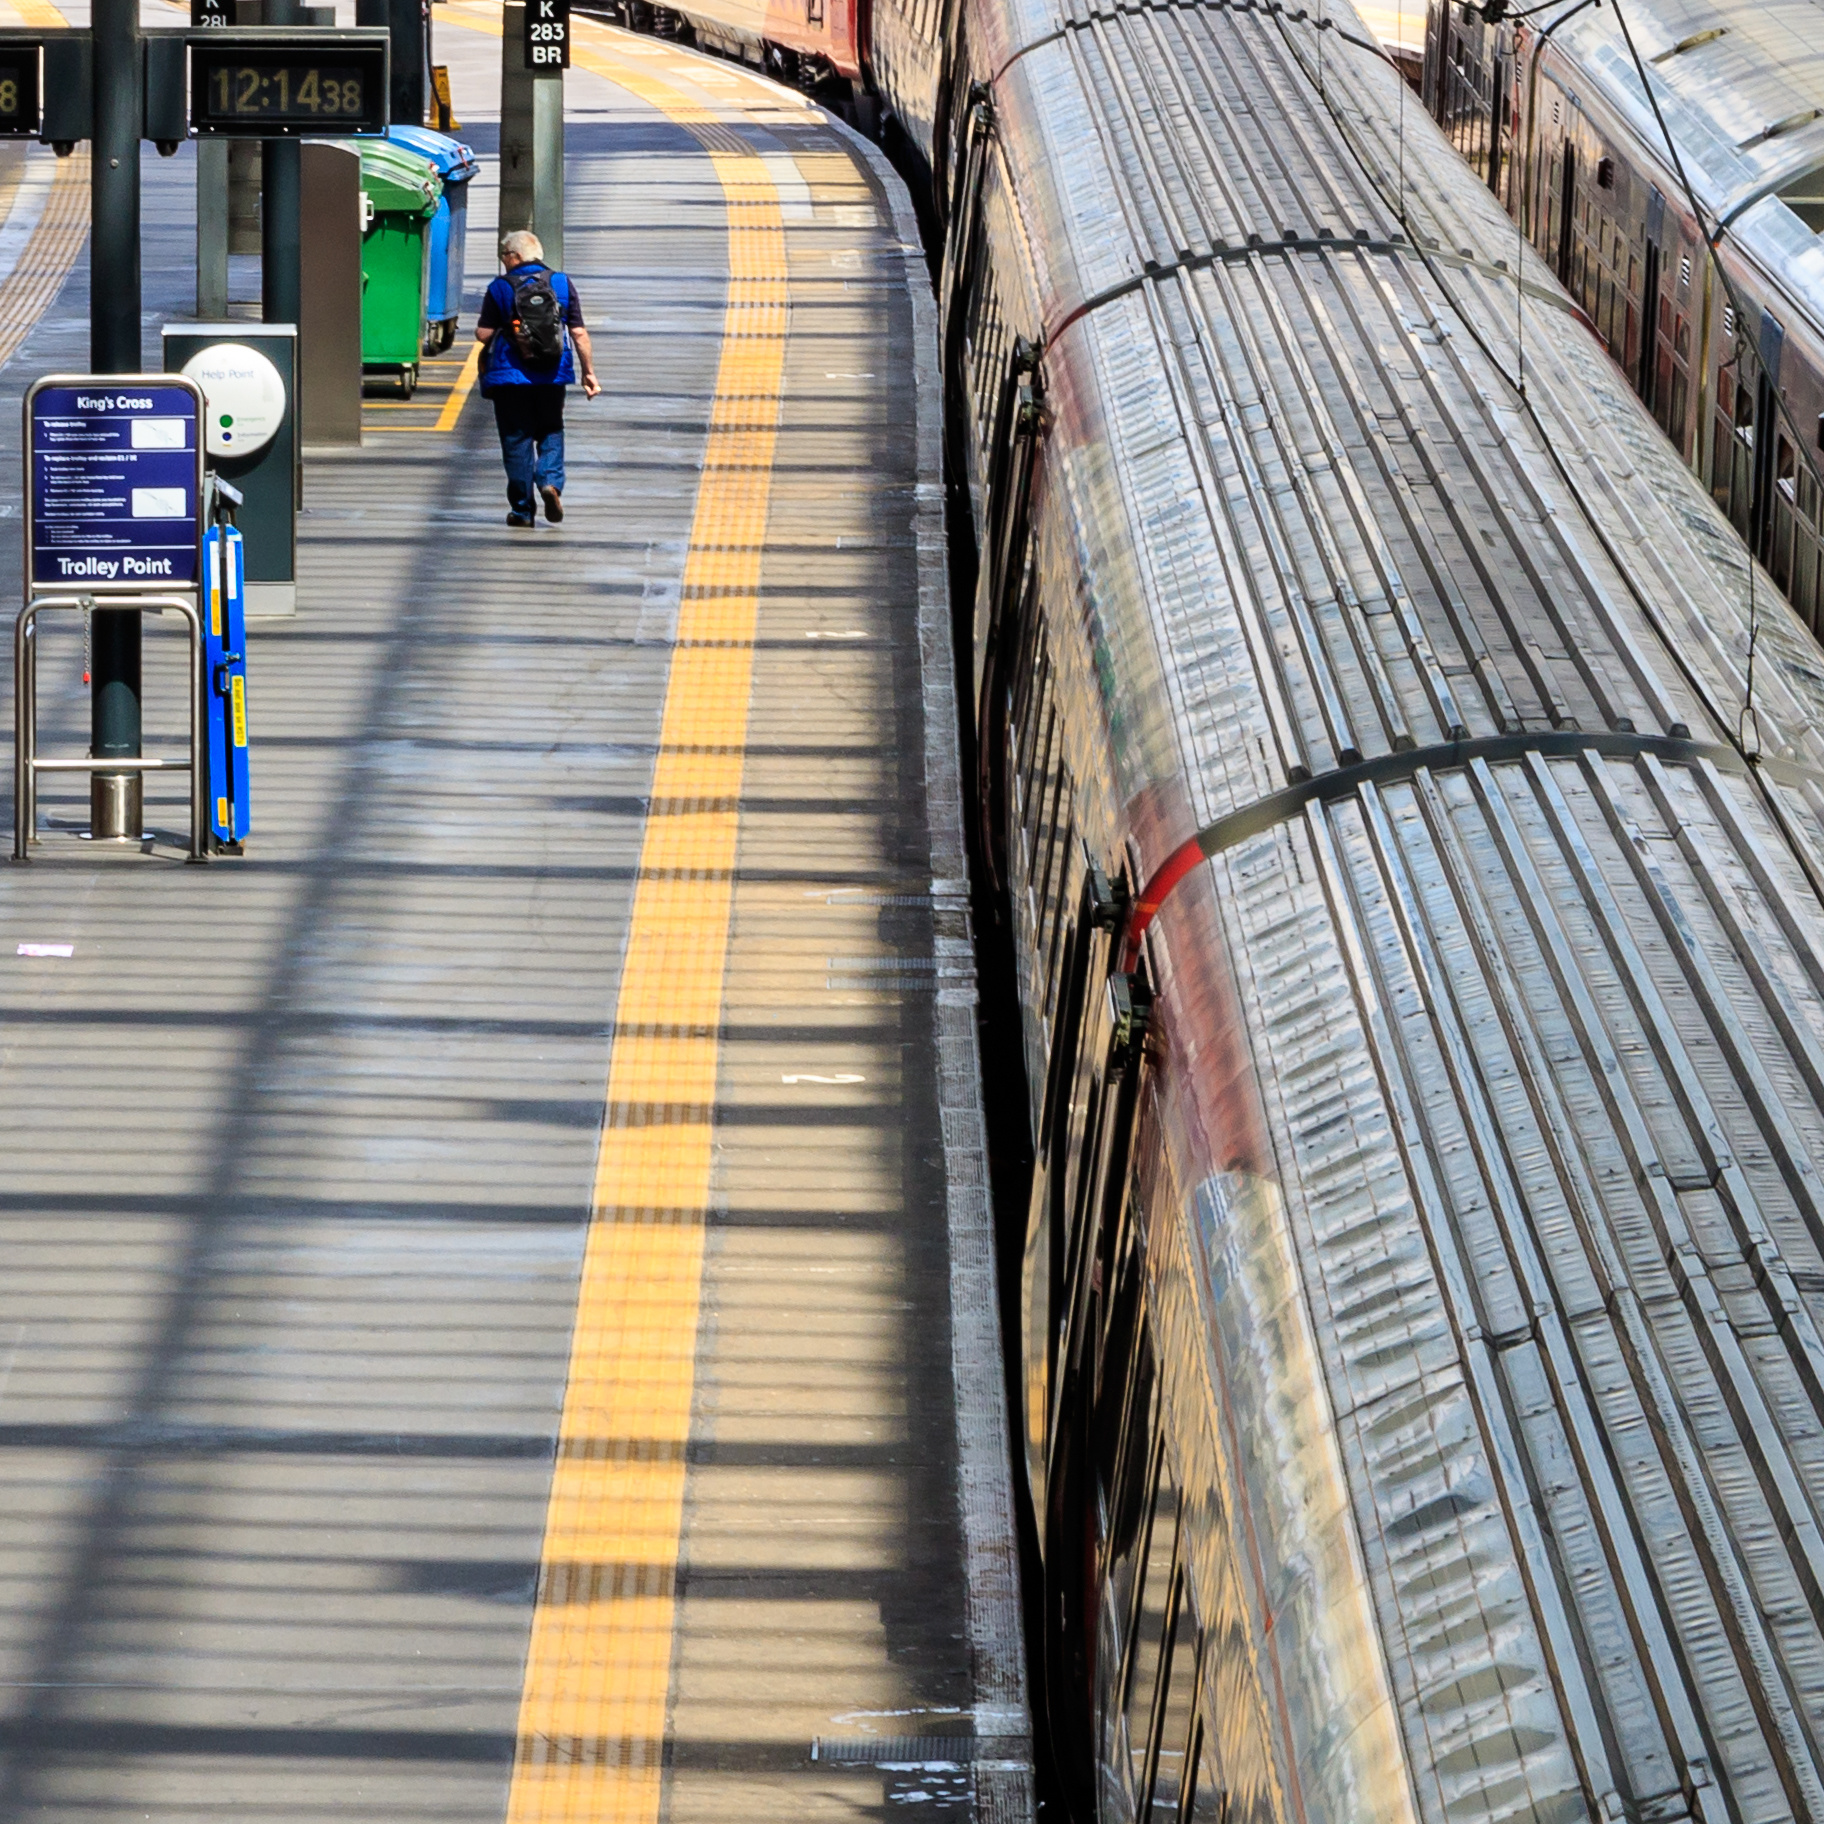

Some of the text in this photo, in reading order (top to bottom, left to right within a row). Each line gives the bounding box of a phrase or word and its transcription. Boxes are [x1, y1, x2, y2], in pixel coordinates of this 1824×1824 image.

[540, 0, 554, 17] K
[530, 22, 565, 41] 283
[532, 46, 562, 64] BR
[201, 369, 254, 380] Help Point
[77, 395, 154, 411] King's Cross
[57, 556, 173, 578] Trolley Point
